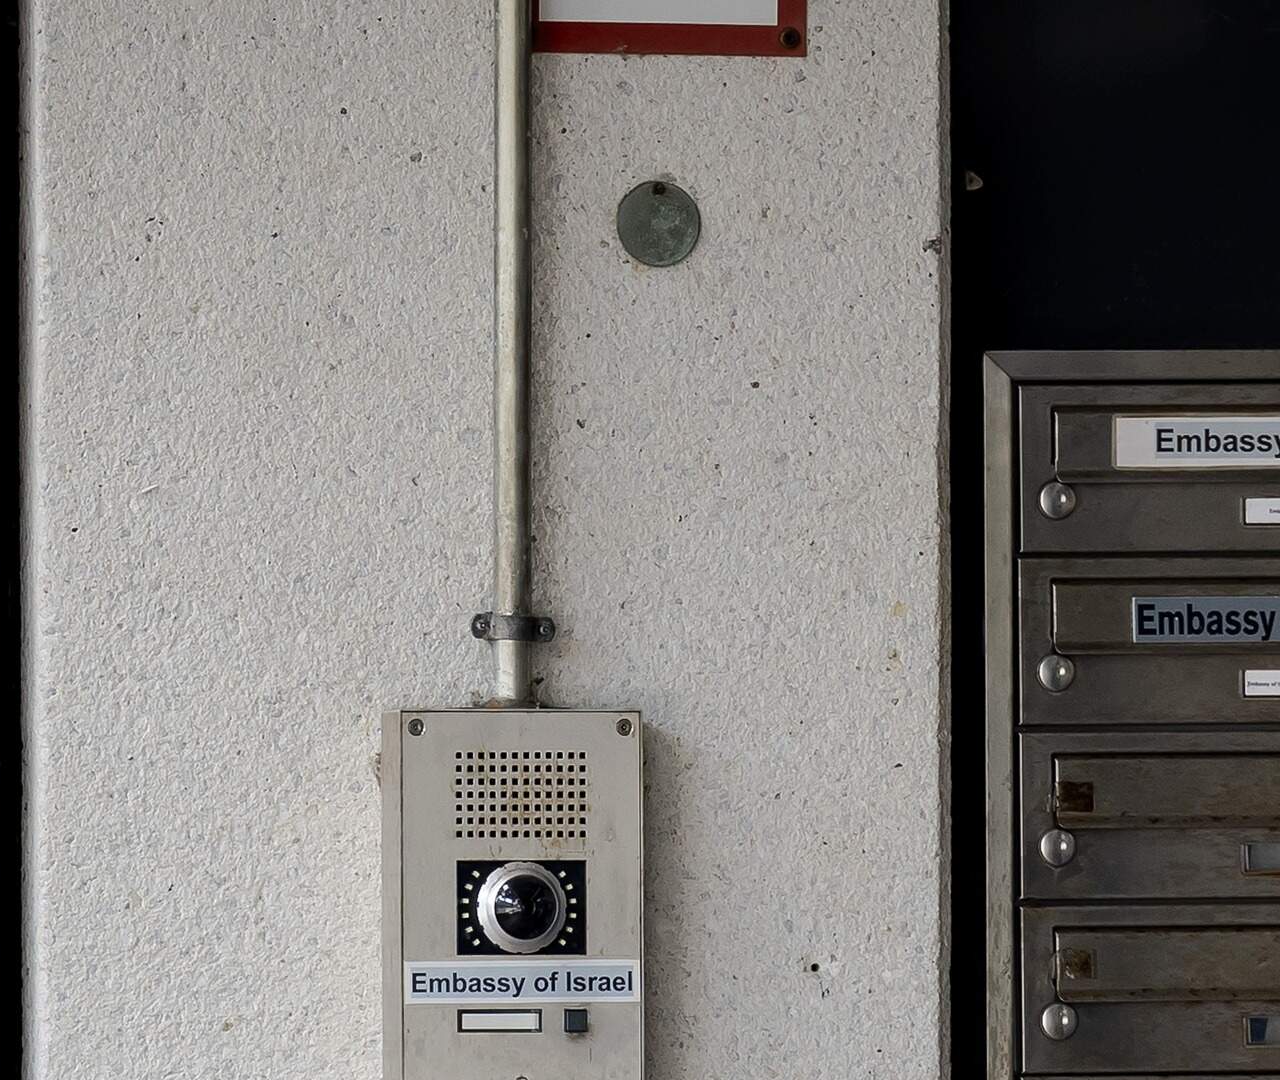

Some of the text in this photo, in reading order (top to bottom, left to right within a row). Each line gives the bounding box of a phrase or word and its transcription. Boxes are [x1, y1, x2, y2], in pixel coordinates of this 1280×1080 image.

[1137, 603, 1275, 641] Embassy
[411, 971, 633, 997] Embassy of Israel
